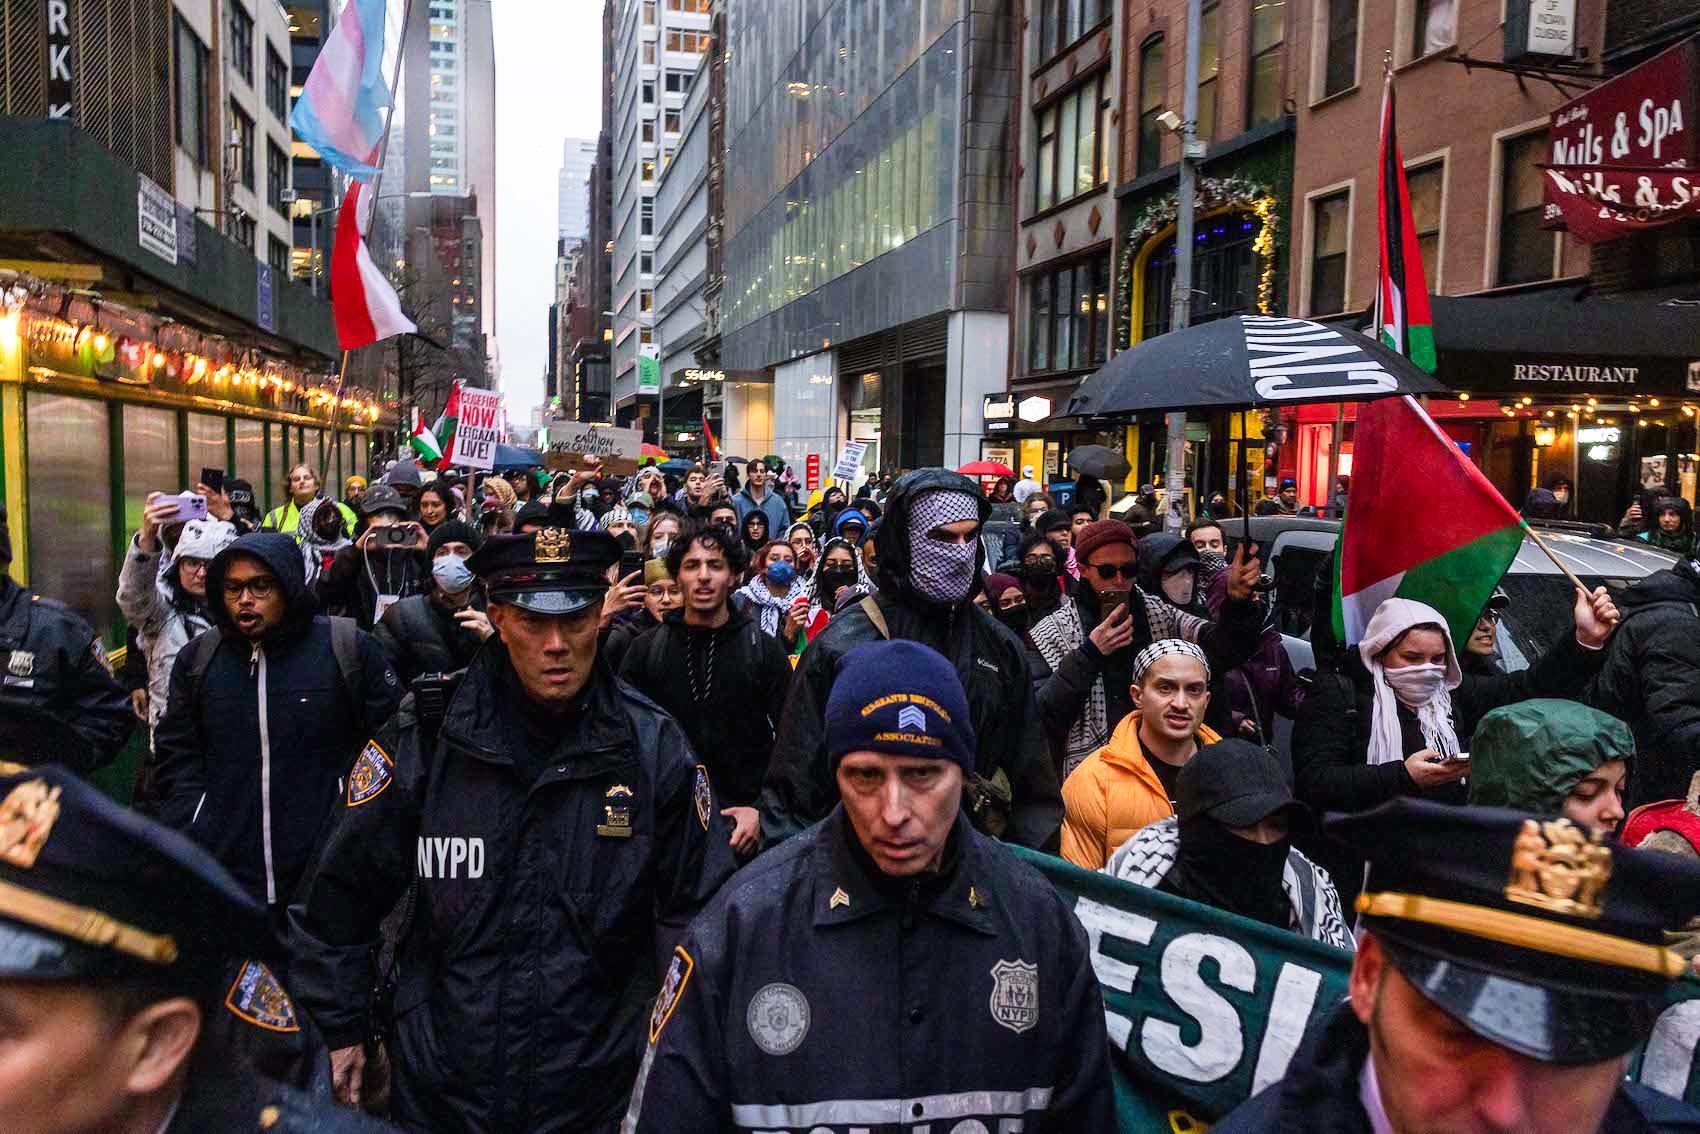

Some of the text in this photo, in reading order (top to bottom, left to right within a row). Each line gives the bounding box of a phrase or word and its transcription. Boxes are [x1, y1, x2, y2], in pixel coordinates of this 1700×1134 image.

[1611, 112, 1630, 158] &
[1513, 364, 1639, 384] RESTAURANT
[461, 405, 496, 429] NOW
[460, 439, 489, 460] LIVE!
[417, 836, 485, 879] NYPD
[1001, 1008, 1035, 1021] NYPD
